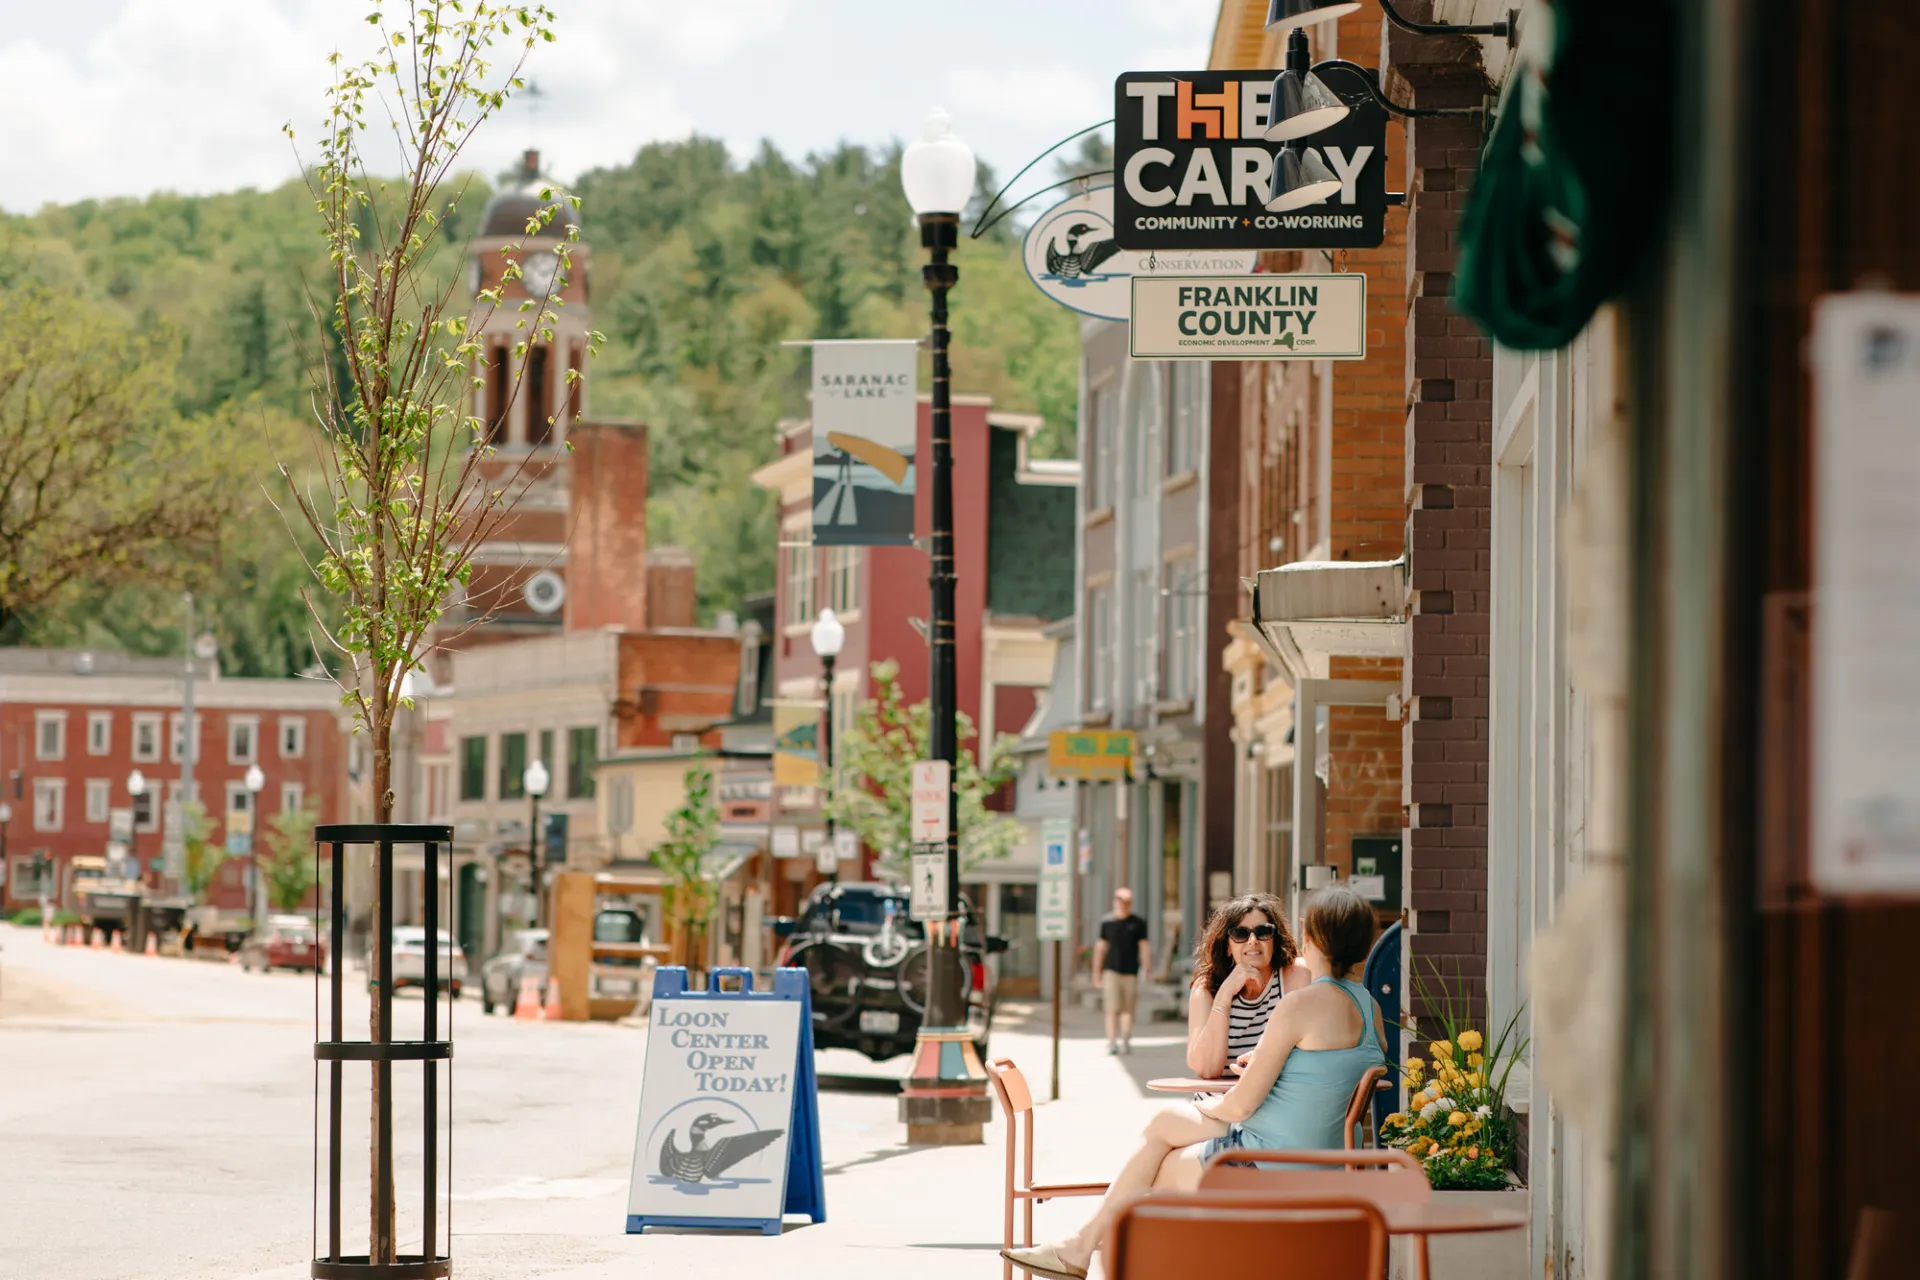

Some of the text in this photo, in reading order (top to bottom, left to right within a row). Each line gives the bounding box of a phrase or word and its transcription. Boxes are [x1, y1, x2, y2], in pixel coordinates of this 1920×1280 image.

[1126, 81, 1274, 140] THE
[1135, 216, 1237, 230] COMMUNITY
[1254, 215, 1363, 229] CO-WORKING
[1178, 286, 1318, 306] FRANKLIN
[1177, 310, 1317, 336] COUNTY
[821, 375, 908, 386] SARANAC
[844, 388, 887, 398] LAKE
[657, 1008, 730, 1027] LOON
[671, 1029, 770, 1049] CENTER
[687, 1050, 758, 1070] OPEN
[694, 1072, 787, 1093] TODAY!
